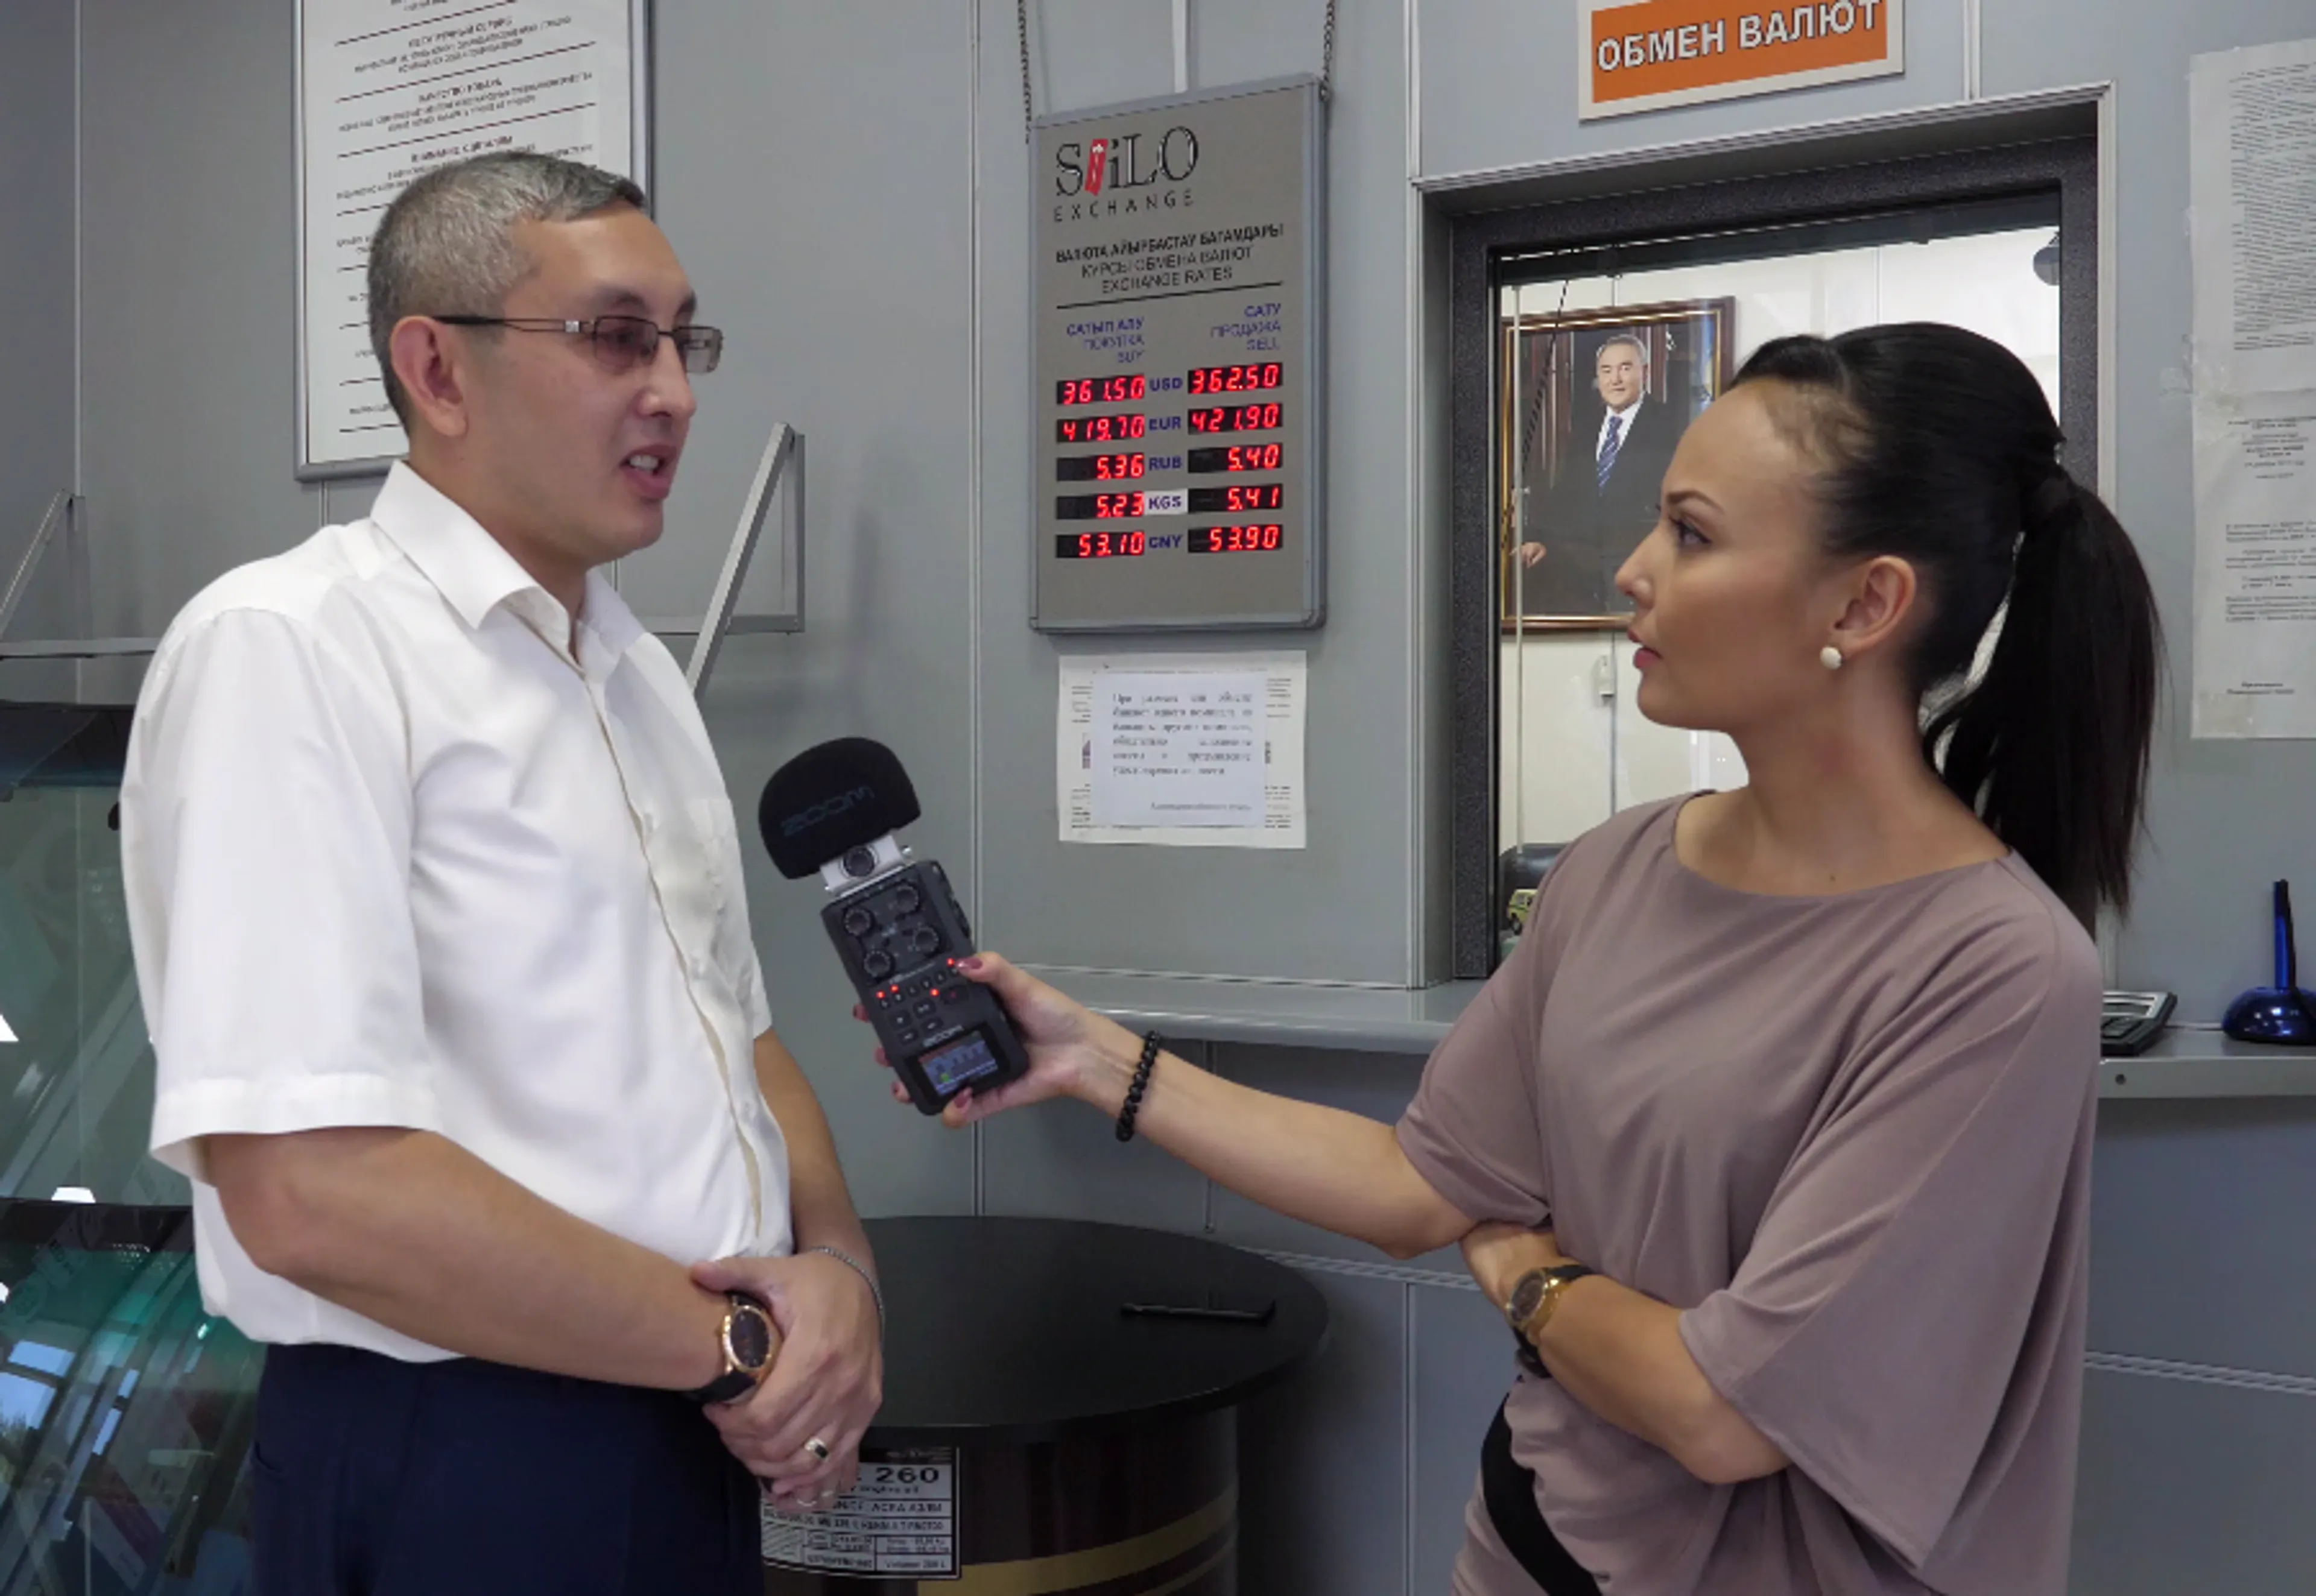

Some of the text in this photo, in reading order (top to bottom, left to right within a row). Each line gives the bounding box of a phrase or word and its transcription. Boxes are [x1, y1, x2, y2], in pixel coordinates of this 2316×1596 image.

[1597, 0, 1882, 72] ОБМЕН ВАЛЮТ
[1054, 188, 1194, 223] EXCHANGE
[1102, 266, 1233, 294] EXCHANGE RATES
[1244, 303, 1282, 317] САТУ
[1063, 364, 1279, 405] 361.50 USD 362.50
[1063, 403, 1279, 441] 419.70 EUR 421.90
[1096, 444, 1279, 480] 5.36 RUB 5.40
[1096, 485, 1279, 518] 5.23 KGS 5.41
[1078, 525, 1279, 557] 53.10 CNY 53.90
[875, 1466, 940, 1484] 260
